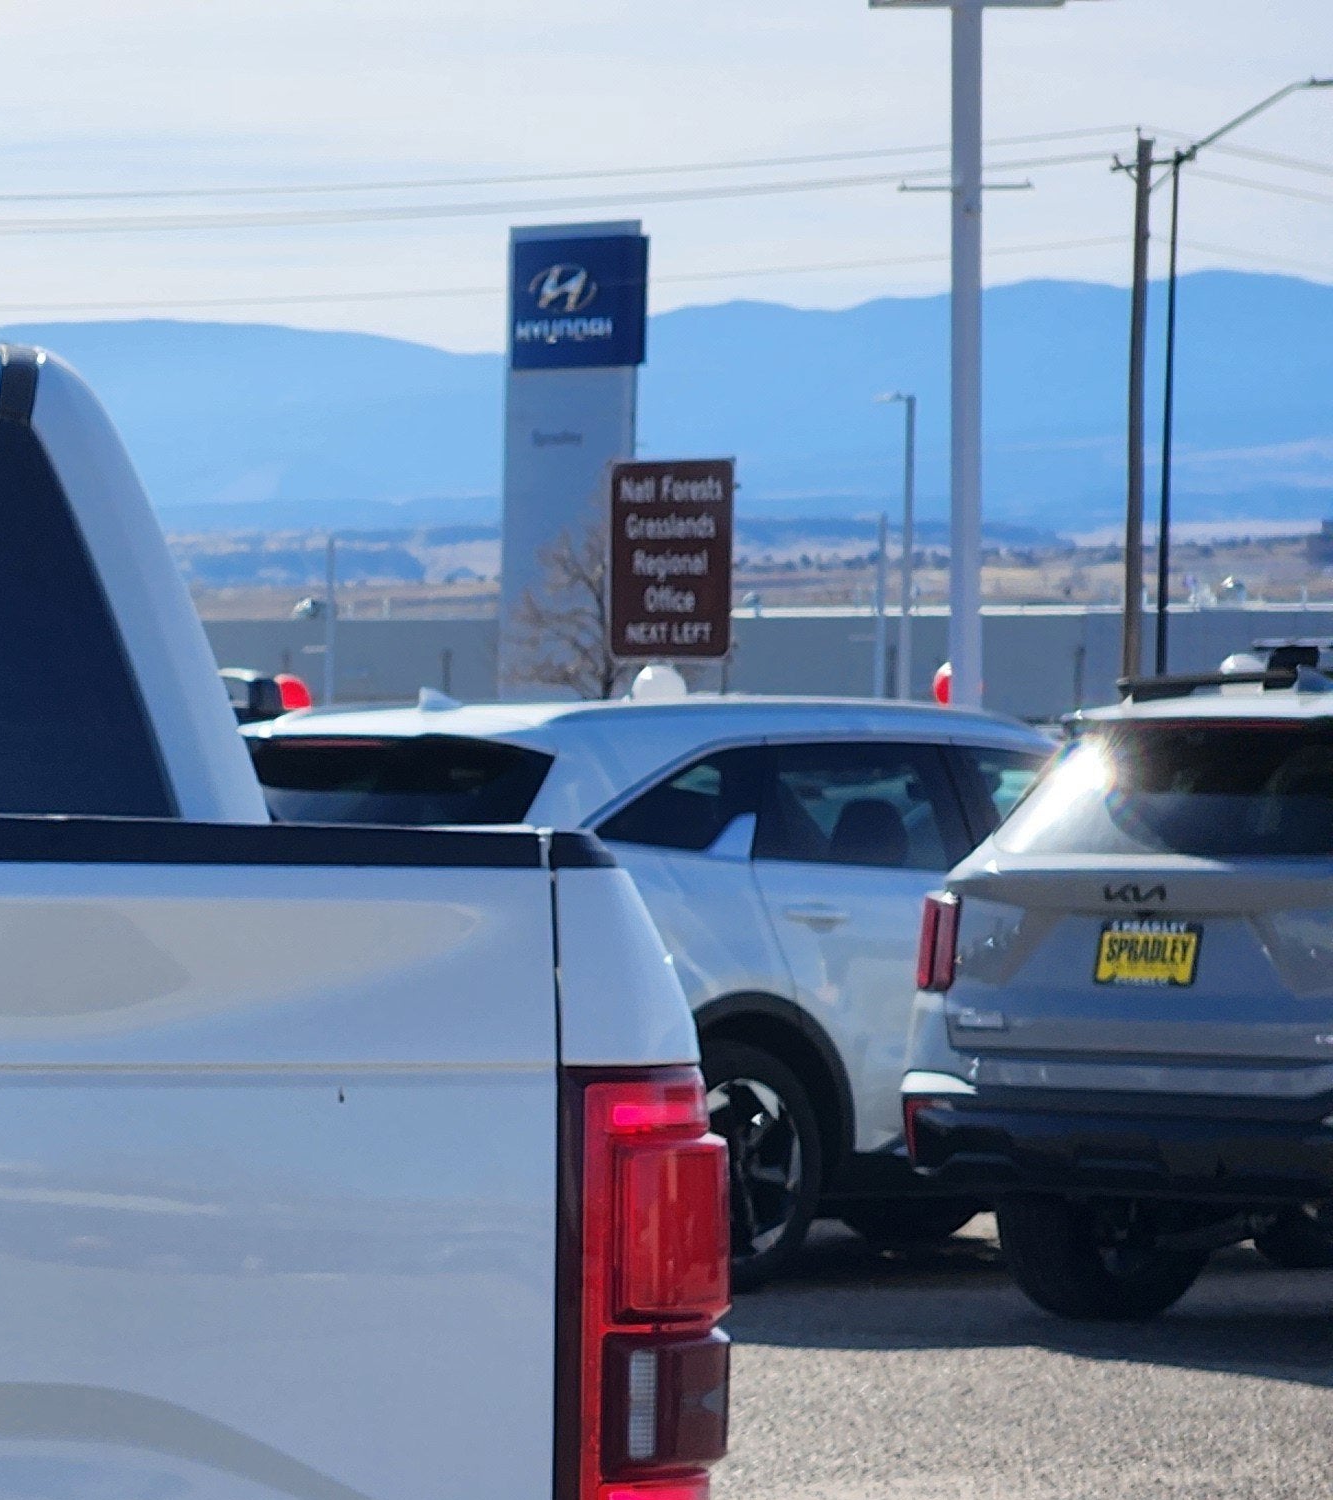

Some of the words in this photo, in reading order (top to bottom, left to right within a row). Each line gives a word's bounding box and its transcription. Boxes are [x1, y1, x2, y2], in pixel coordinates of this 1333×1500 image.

[661, 473, 723, 502] Forests
[624, 512, 717, 540] Grasslands
[633, 549, 708, 582] Regional
[644, 584, 696, 613] Office
[625, 621, 668, 645] NEXT
[671, 620, 713, 645] LEFT
[1106, 938, 1190, 965] SPRADLEY
